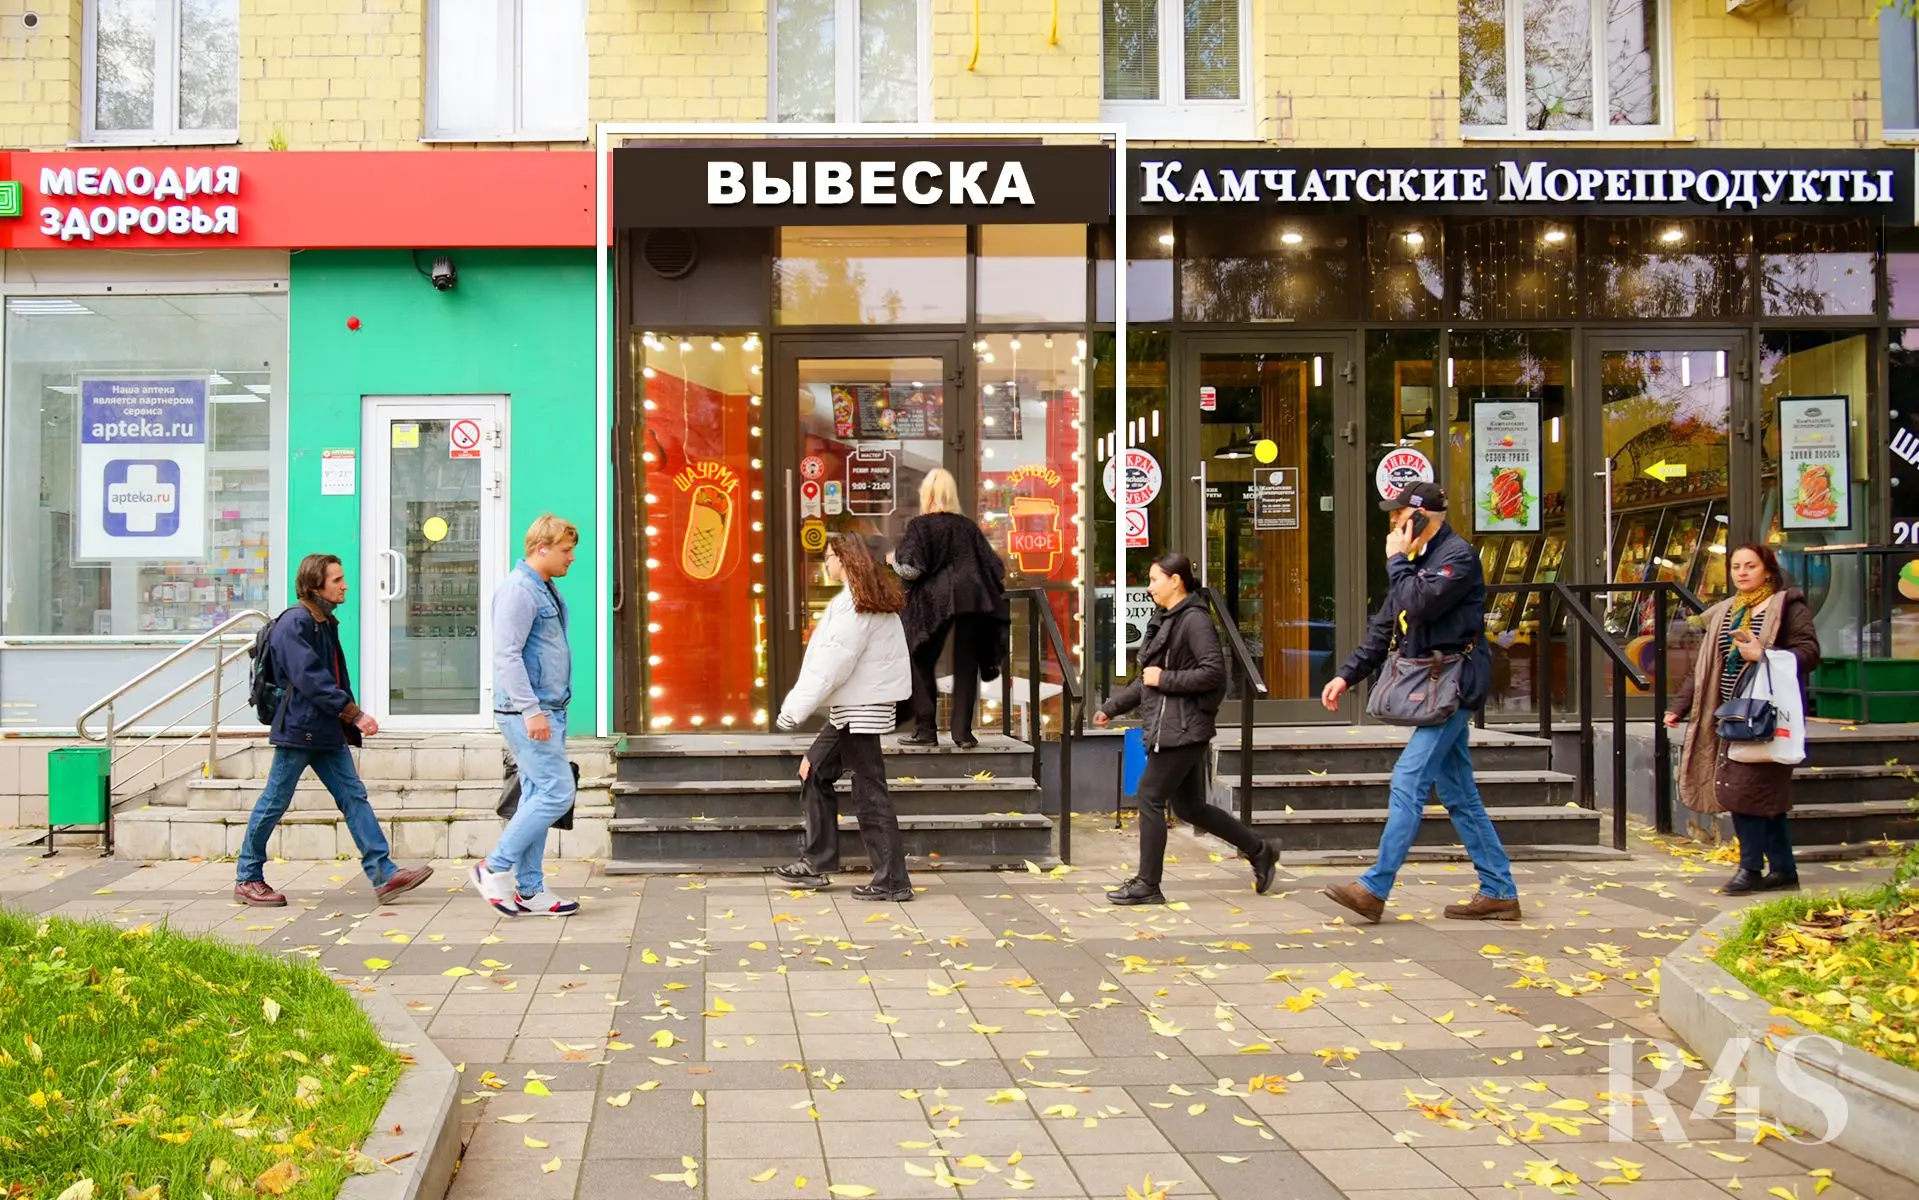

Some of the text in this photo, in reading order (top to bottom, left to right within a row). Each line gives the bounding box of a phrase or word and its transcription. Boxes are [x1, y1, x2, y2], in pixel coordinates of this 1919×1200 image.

[40, 166, 240, 201] МЕЛОДИЯ
[707, 161, 1036, 205] ВЫВЕСКА
[40, 205, 238, 241] ЗДОРОВЬЯ
[112, 385, 175, 395] Наша аптека
[93, 397, 194, 407] является партнером
[123, 408, 163, 416] сервиса
[92, 419, 194, 441] apteka.ru
[673, 462, 739, 493] ШАУРМА
[851, 482, 866, 490] 9:00
[872, 482, 891, 490] 21:00
[112, 492, 170, 505] apteka.ru
[1015, 535, 1055, 550] КОФЕ
